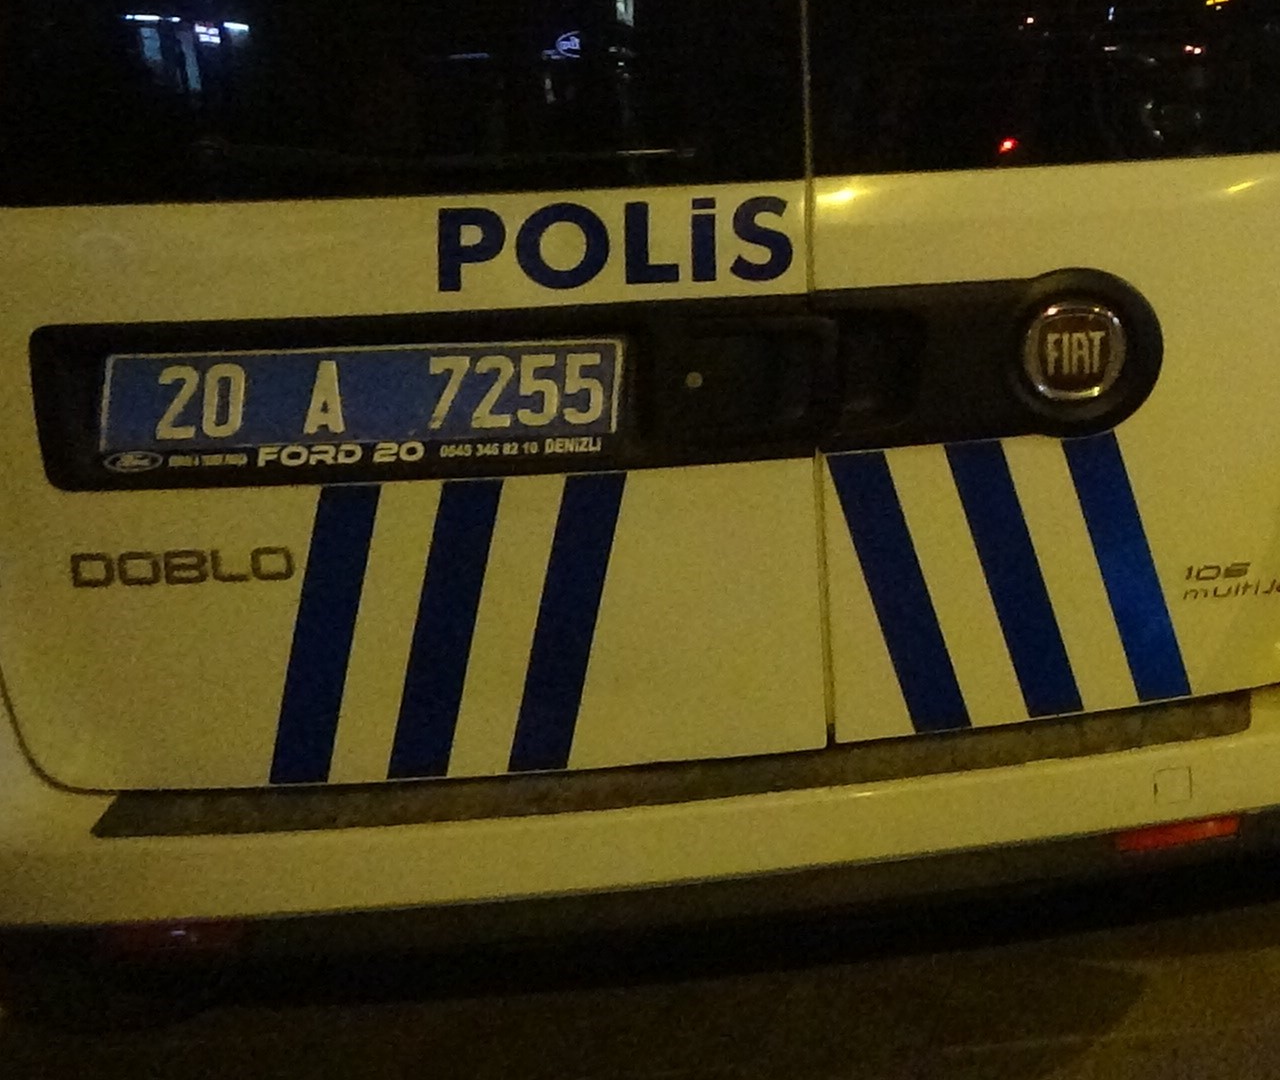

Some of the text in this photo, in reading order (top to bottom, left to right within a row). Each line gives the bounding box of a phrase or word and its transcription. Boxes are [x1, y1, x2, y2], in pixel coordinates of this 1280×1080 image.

[1046, 331, 1106, 377] FIAT
[155, 352, 605, 440] 20 A 7255
[256, 443, 363, 468] FORD
[372, 440, 426, 465] 20
[70, 547, 295, 589] DOBLO
[1185, 561, 1252, 581] 105
